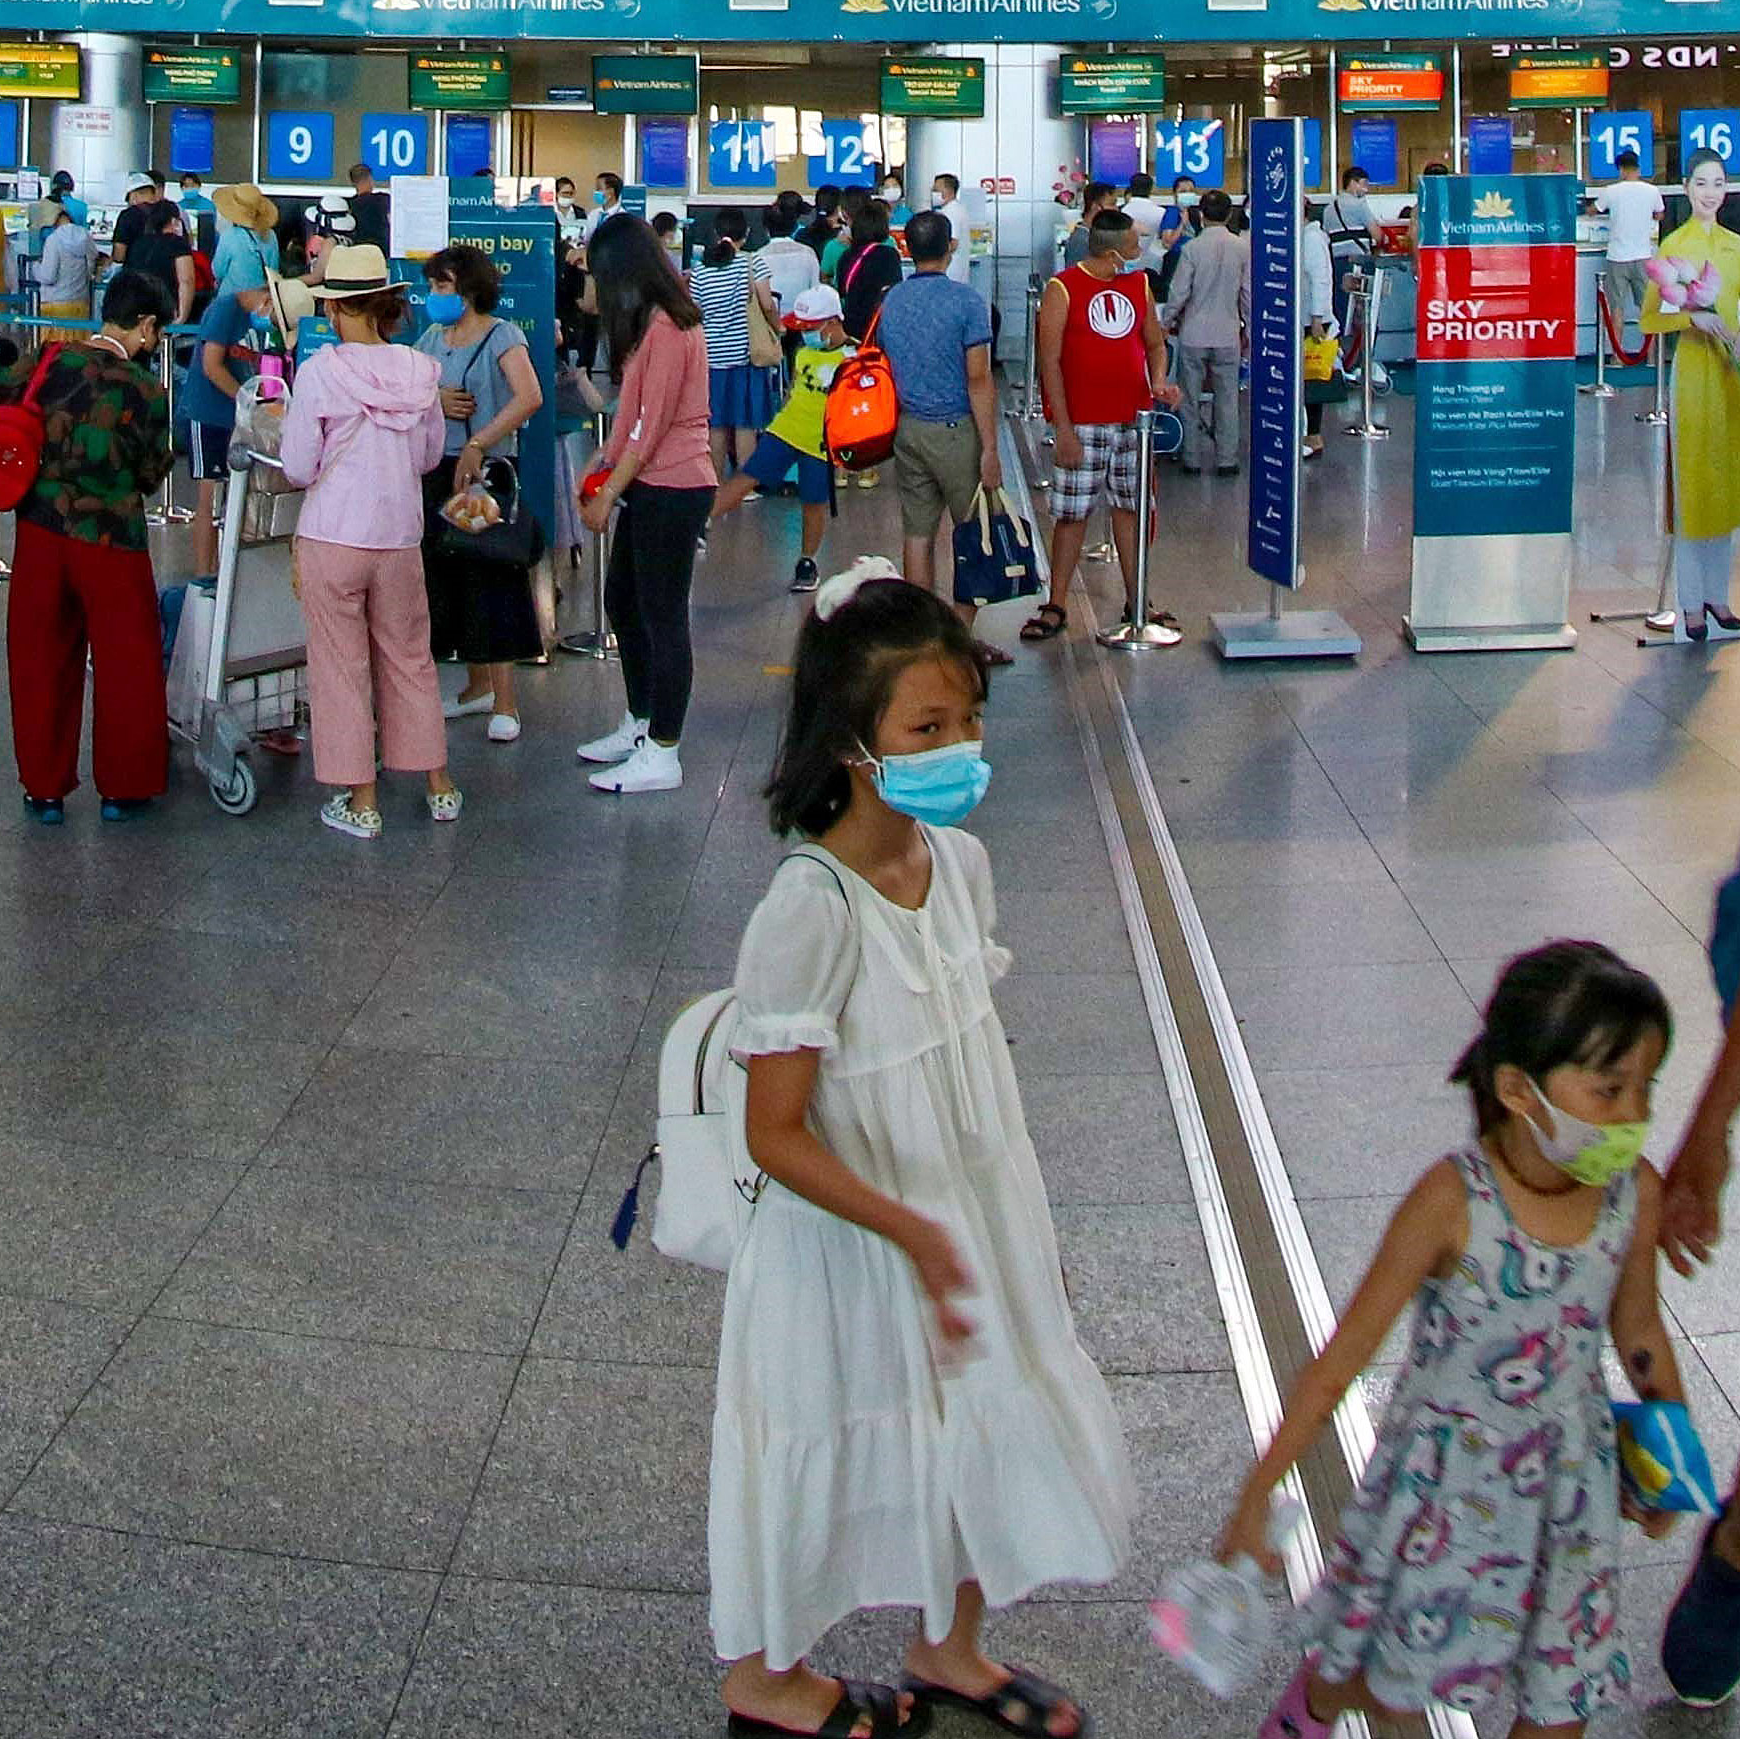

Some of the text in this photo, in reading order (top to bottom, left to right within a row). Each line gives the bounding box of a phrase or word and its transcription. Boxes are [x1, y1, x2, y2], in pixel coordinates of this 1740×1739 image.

[1349, 75, 1373, 85] SKY
[1349, 84, 1403, 94] PRIORITY
[288, 127, 314, 163] 9
[370, 129, 416, 167] 10
[823, 135, 862, 172] 12
[1164, 135, 1211, 172] 13
[1596, 126, 1639, 165] 15
[1689, 122, 1733, 161] 16
[500, 235, 534, 255] bay
[1427, 299, 1485, 321] SKY
[1427, 319, 1559, 343] PRIORITY
